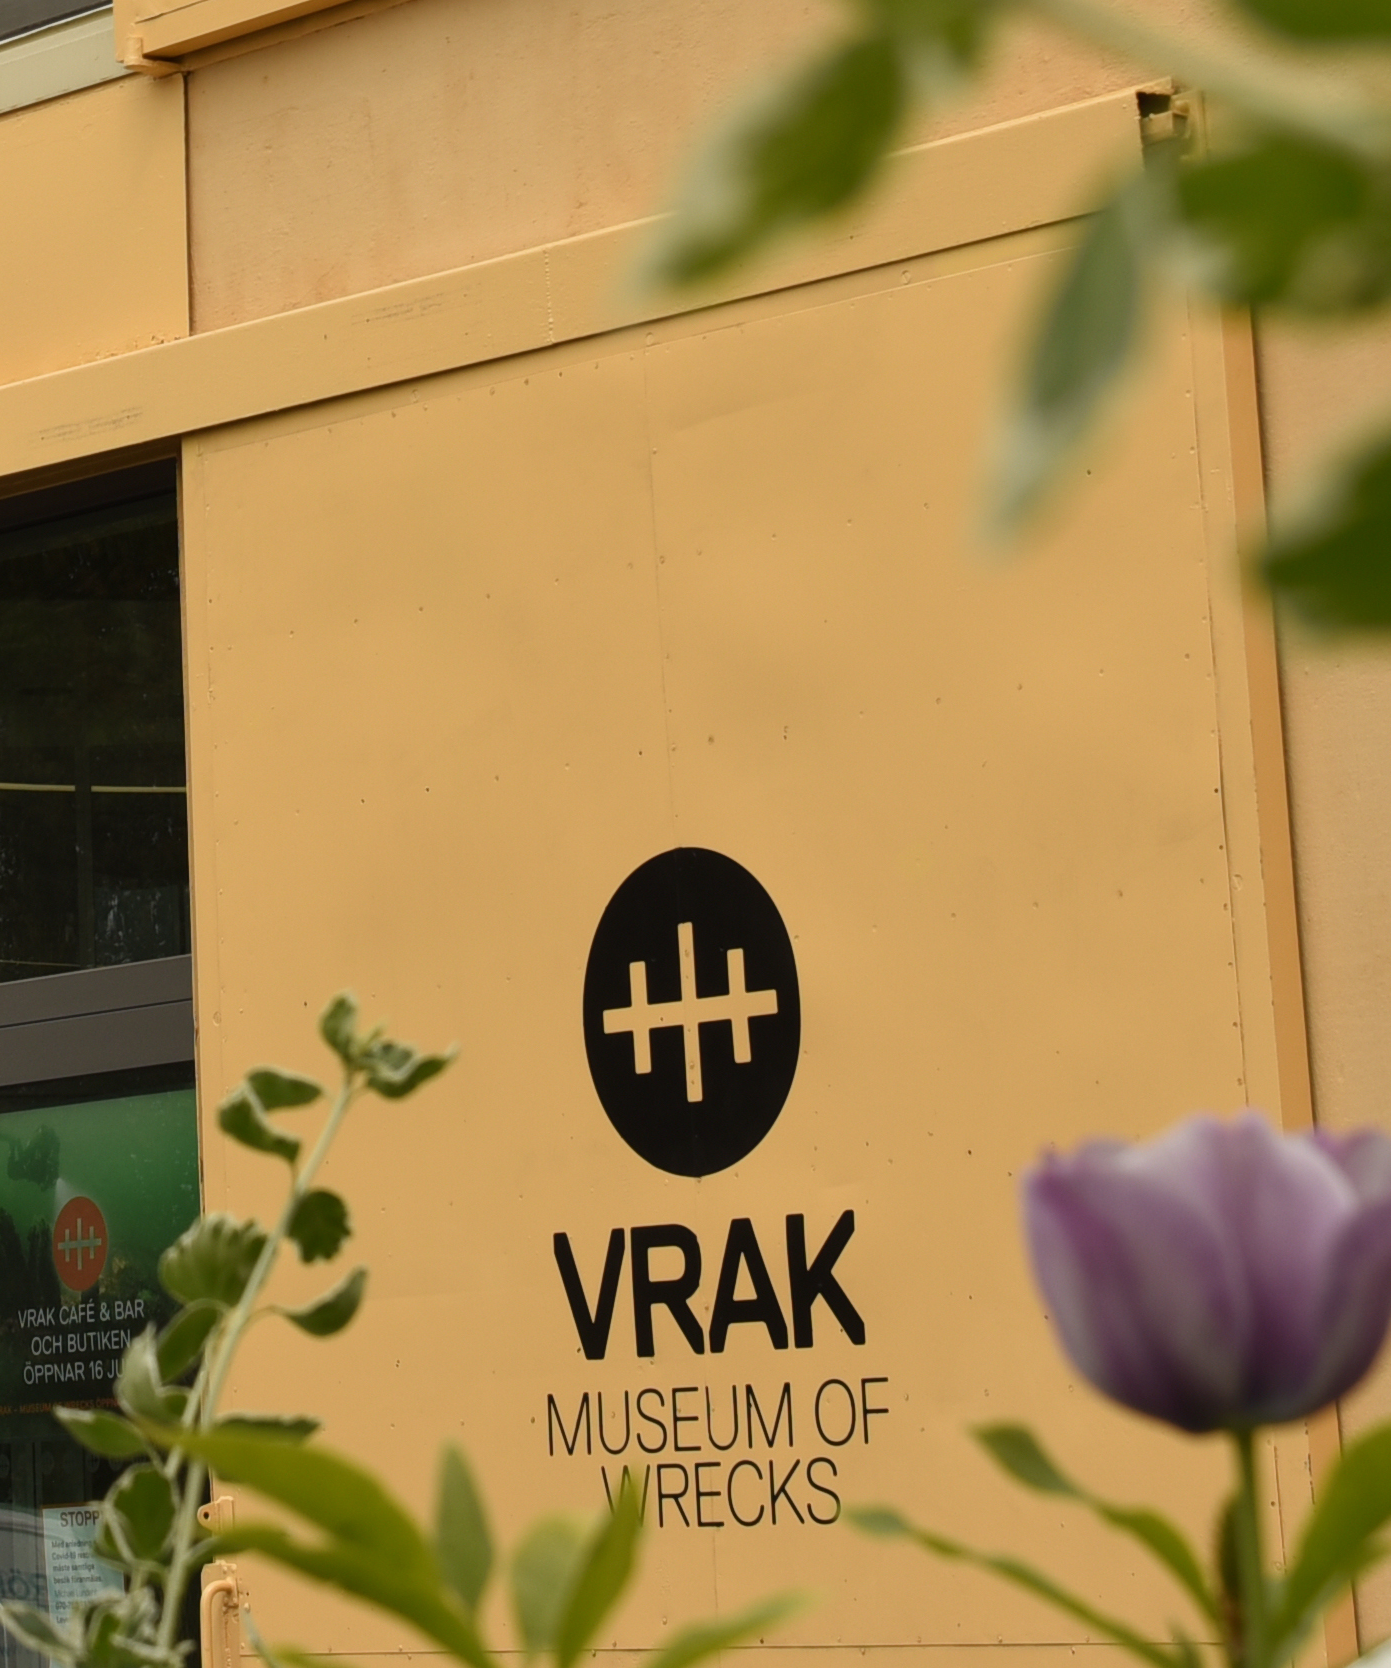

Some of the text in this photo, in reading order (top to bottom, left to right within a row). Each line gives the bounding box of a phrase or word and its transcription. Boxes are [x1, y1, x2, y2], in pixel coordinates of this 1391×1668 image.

[553, 1209, 867, 1361] VRAK
[17, 1298, 145, 1329] VRAK CAFÉ & BAR
[30, 1328, 131, 1356] OCH BUTIKEN
[23, 1358, 125, 1385] ÖPPNAR 16 JU
[546, 1376, 890, 1457] MUSEUM OF
[600, 1456, 842, 1529] WRECKS
